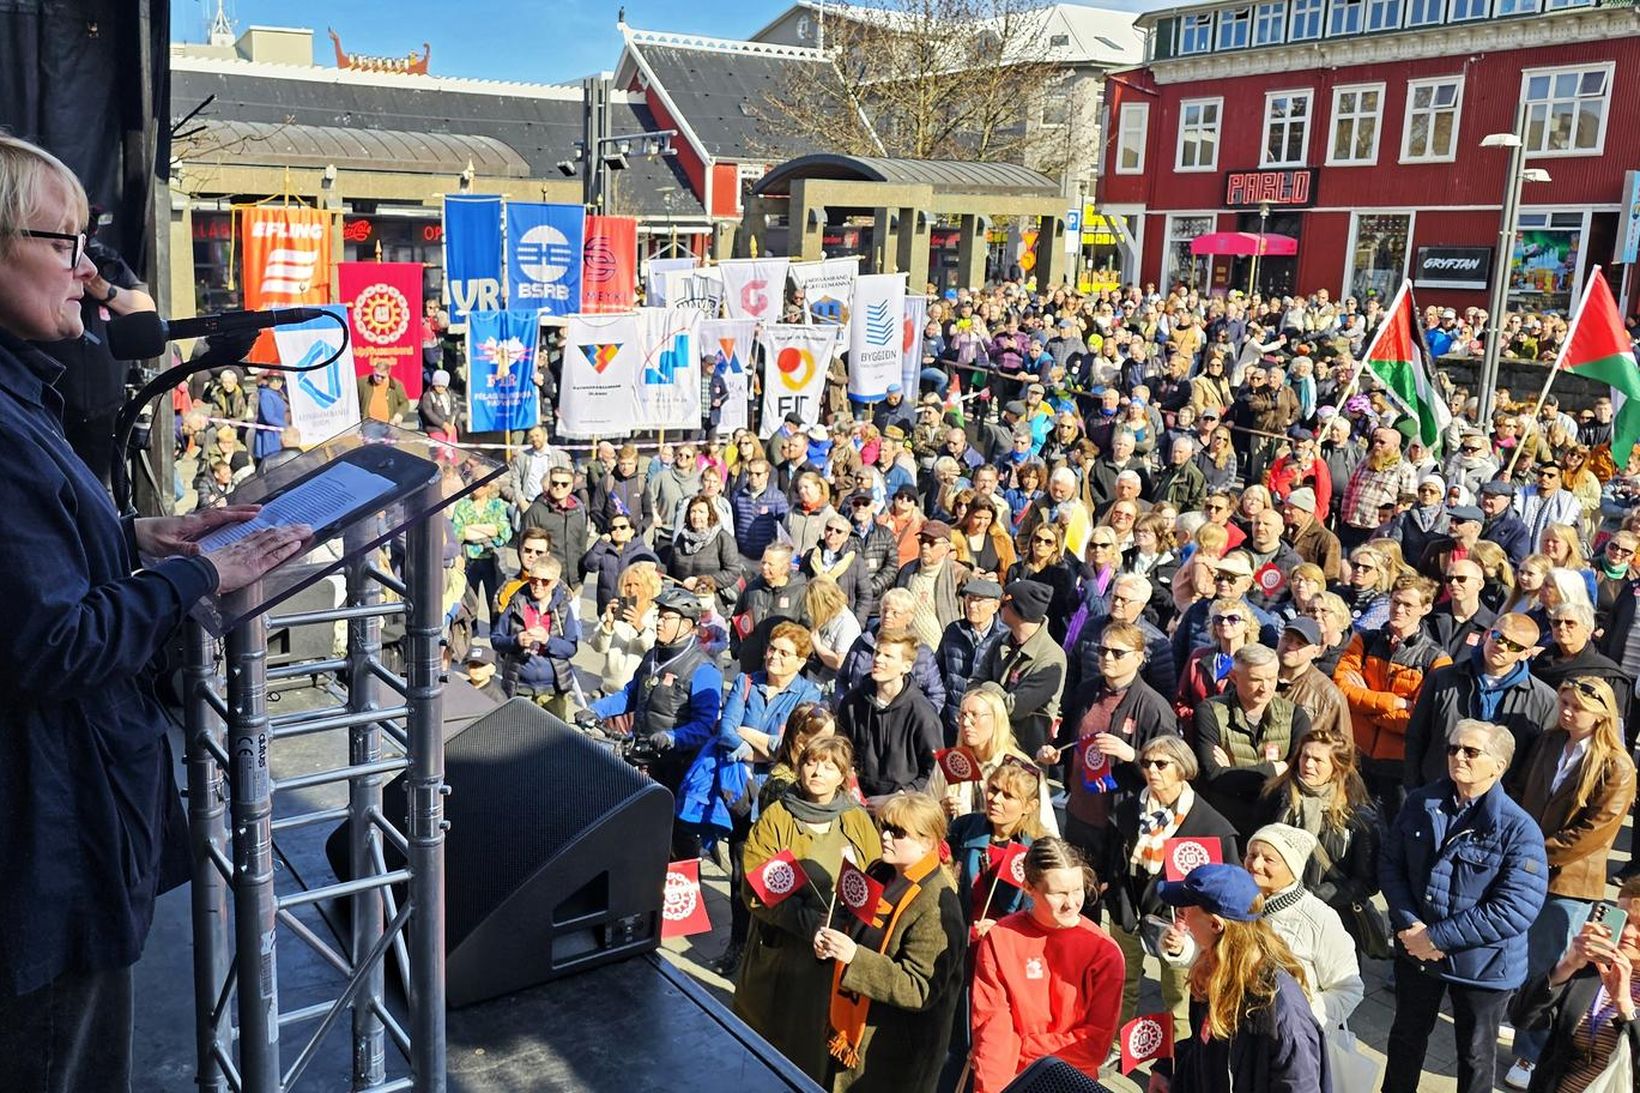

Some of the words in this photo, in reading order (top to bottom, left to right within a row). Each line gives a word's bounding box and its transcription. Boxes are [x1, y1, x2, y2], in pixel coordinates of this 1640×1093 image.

[1226, 171, 1311, 205] PABLO
[252, 221, 323, 239] EFLING
[451, 278, 500, 312] VR
[518, 283, 570, 300] BSRB
